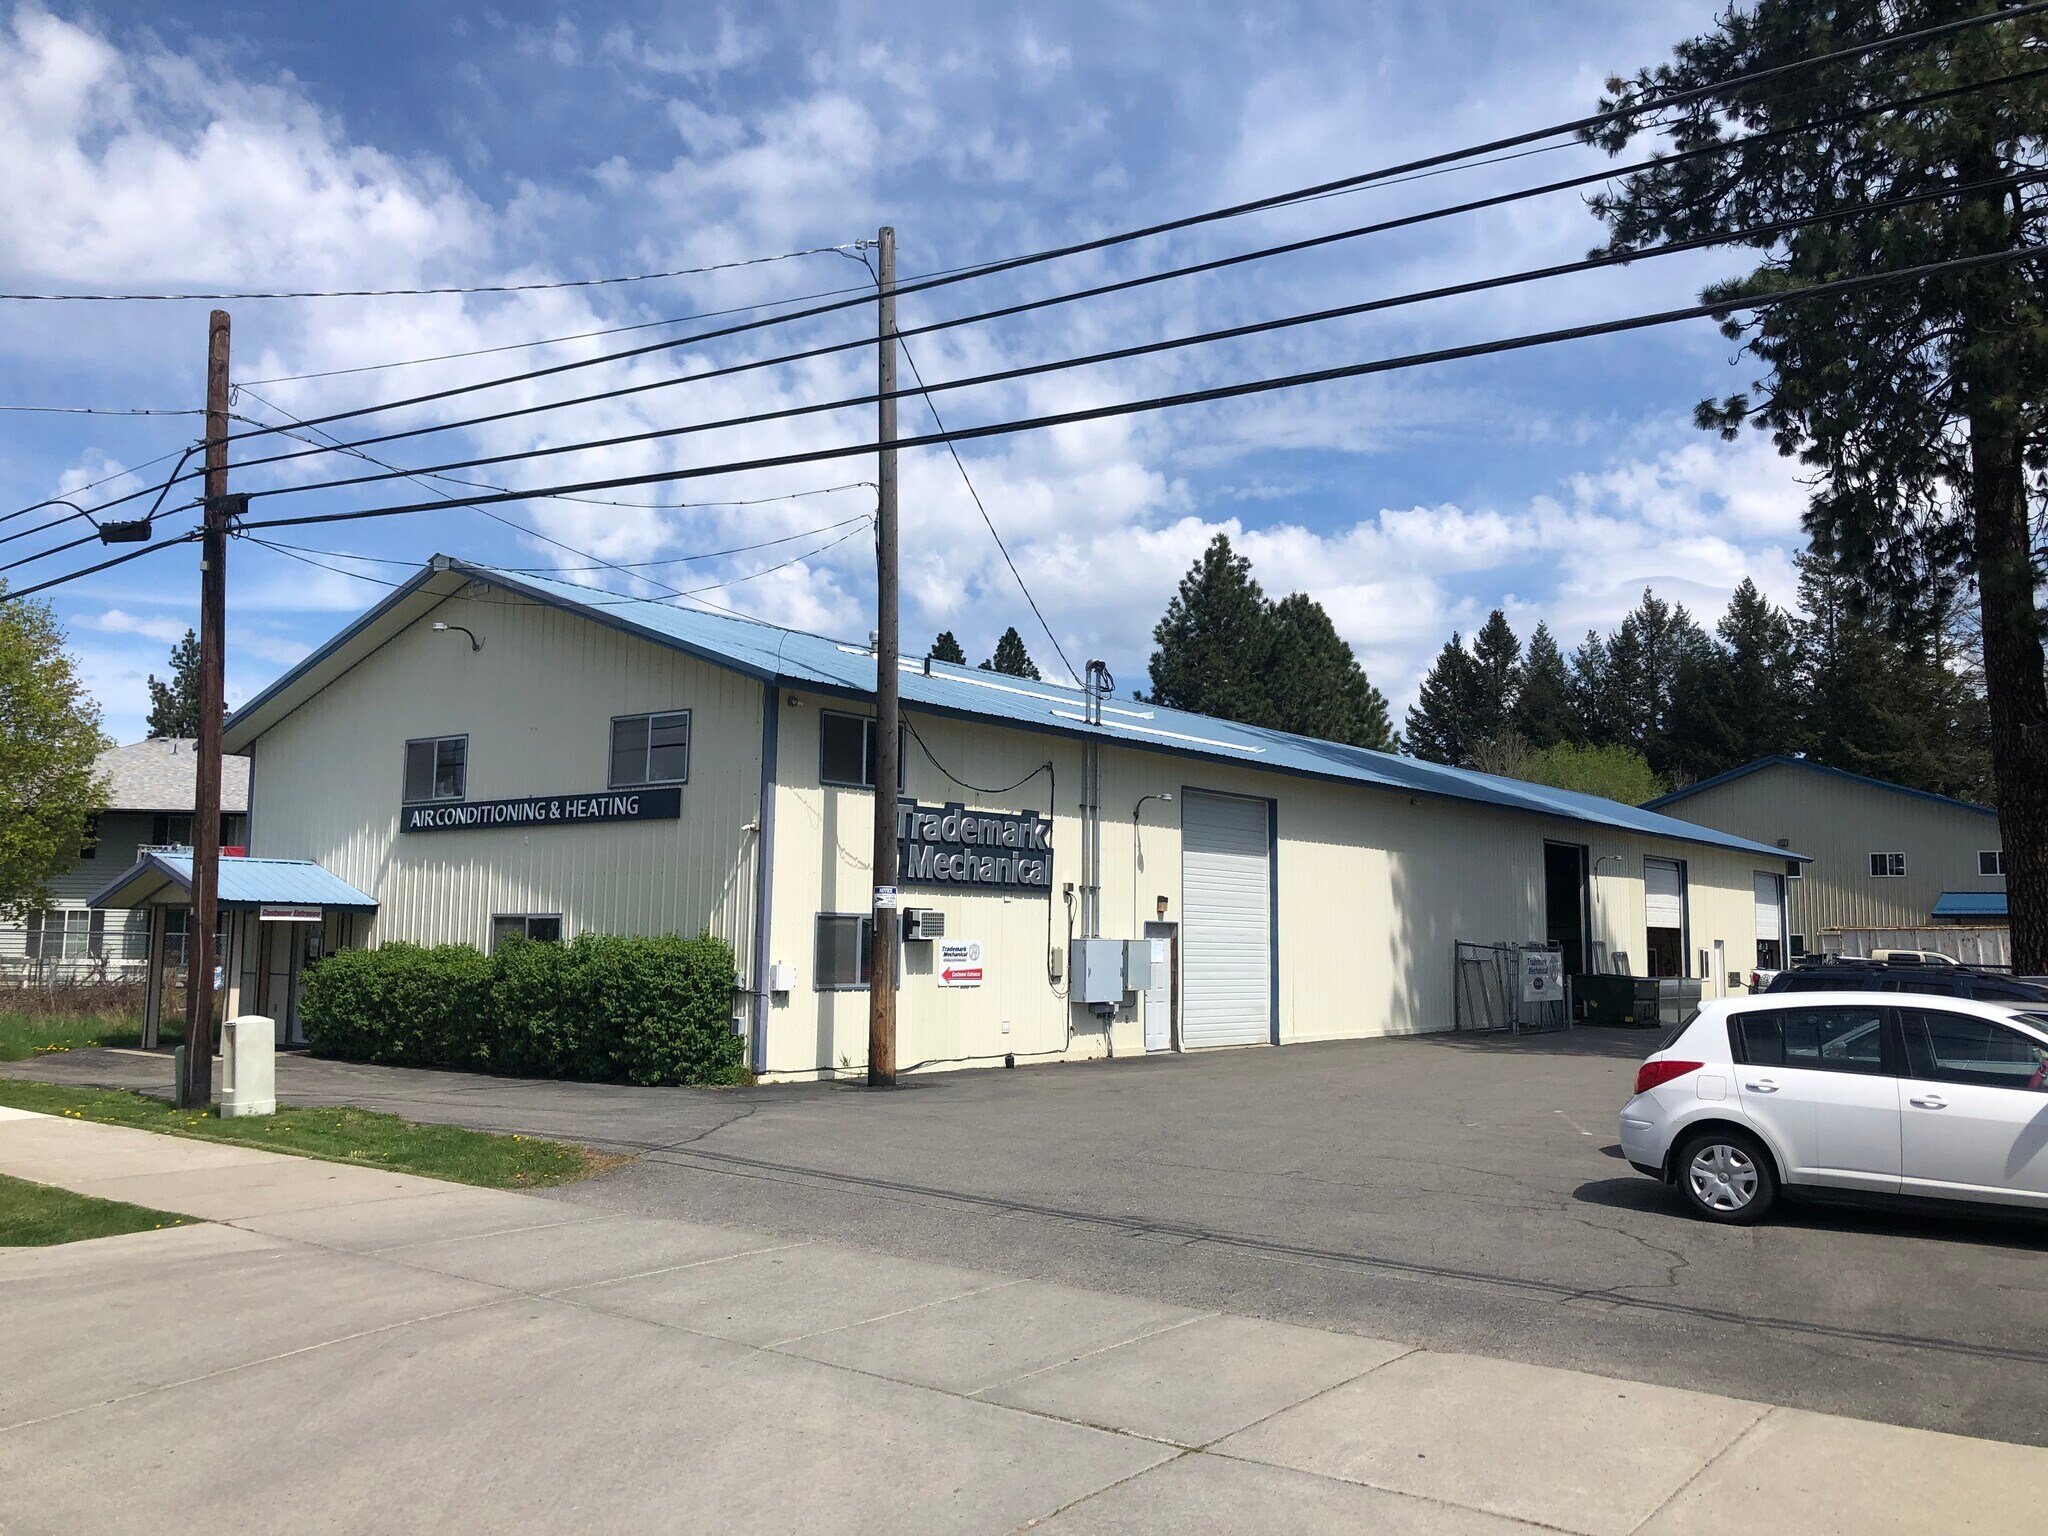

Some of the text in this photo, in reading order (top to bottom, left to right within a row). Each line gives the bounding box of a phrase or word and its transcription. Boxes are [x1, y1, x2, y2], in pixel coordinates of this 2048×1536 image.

[410, 796, 639, 827] AIR CONDITIONING & HEATING
[897, 803, 1047, 850] Trademark
[907, 844, 1051, 886] Mechanical
[262, 909, 320, 918] Customer Entrance
